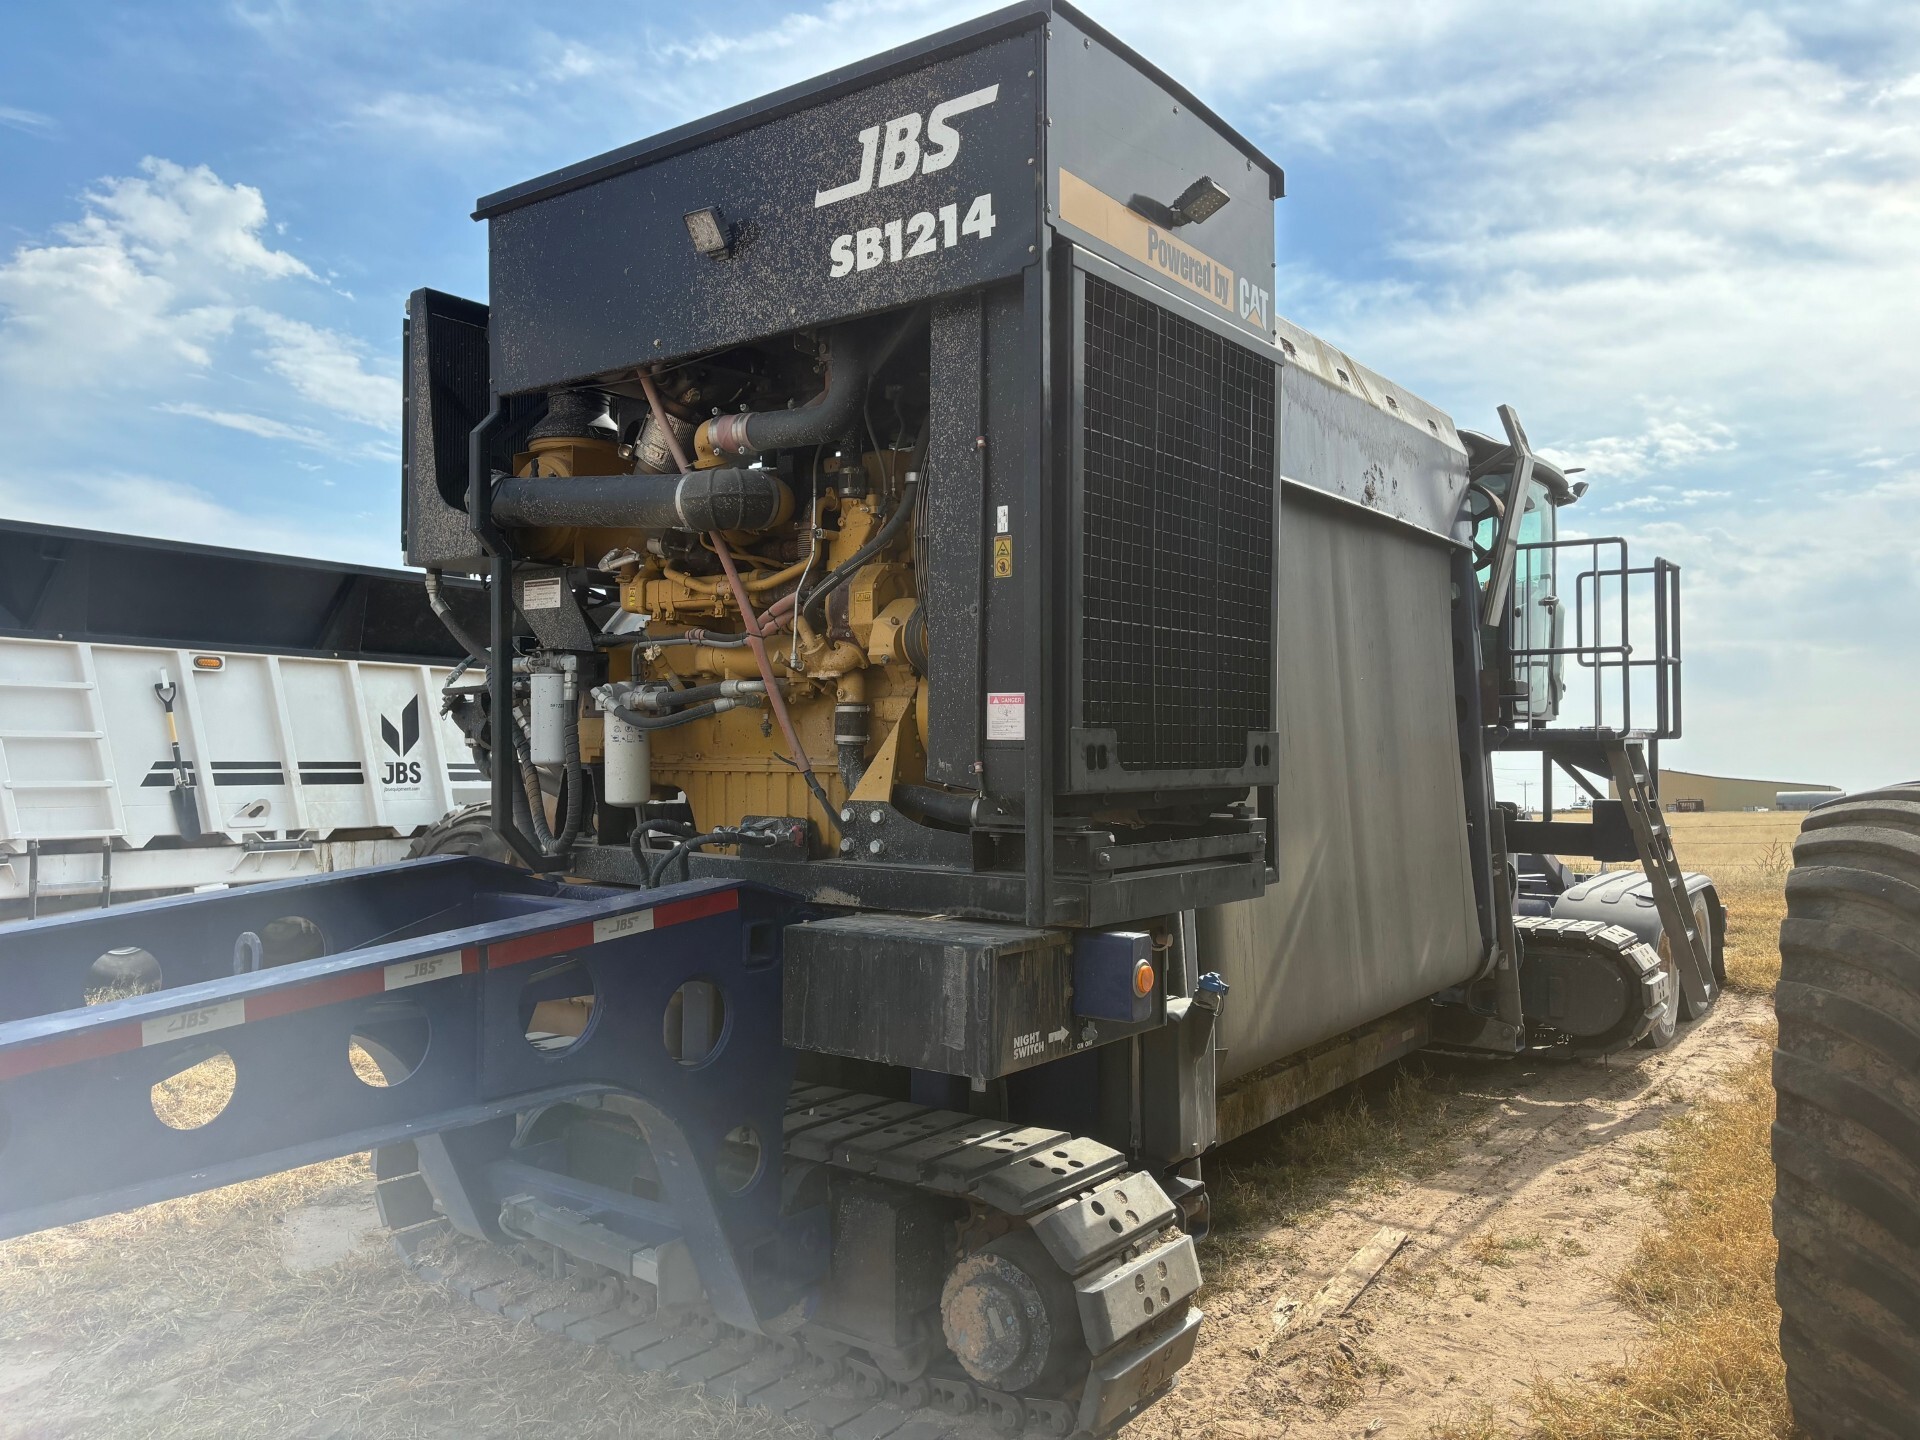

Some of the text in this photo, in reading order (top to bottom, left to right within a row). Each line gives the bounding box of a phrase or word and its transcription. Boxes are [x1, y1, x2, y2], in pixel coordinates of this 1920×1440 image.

[815, 84, 999, 208] JBS
[830, 193, 996, 277] SB1214
[1148, 226, 1230, 304] Powered by
[1239, 277, 1269, 331] CAT
[381, 762, 422, 784] JBS
[609, 916, 639, 933] JBS
[404, 959, 443, 979] JBS
[167, 1007, 218, 1033] JBS
[1013, 1030, 1040, 1049] NIGHT
[1013, 1041, 1045, 1060] SWITCH
